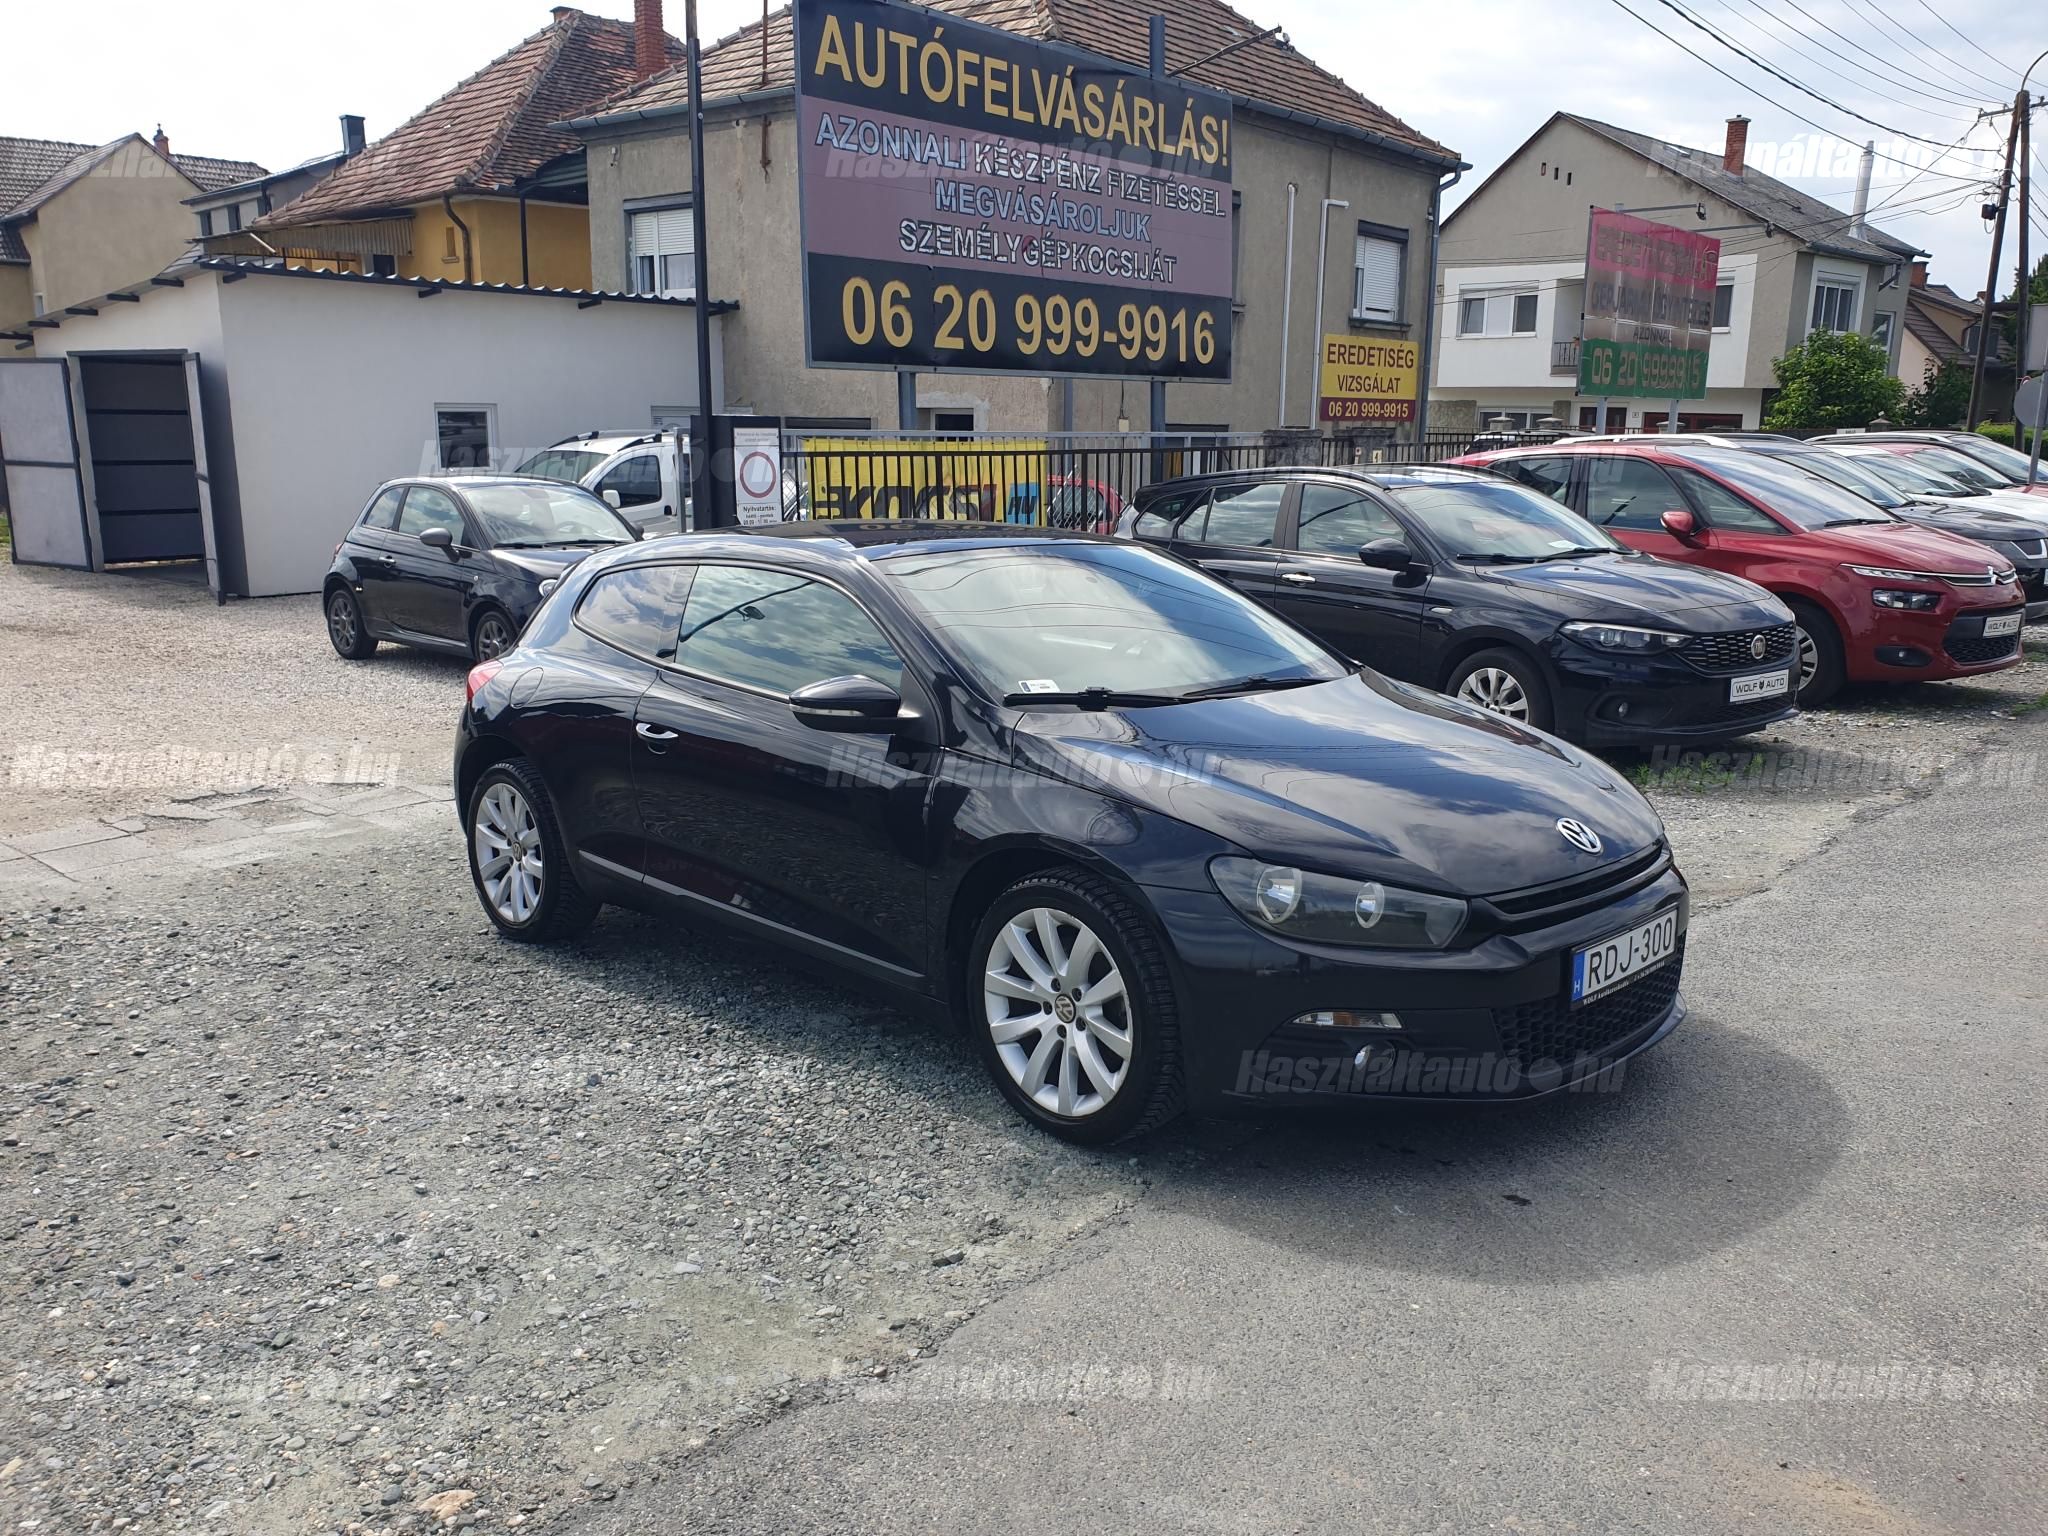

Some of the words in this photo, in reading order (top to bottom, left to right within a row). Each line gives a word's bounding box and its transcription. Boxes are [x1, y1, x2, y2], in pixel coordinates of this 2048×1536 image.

[814, 14, 1228, 166] AUTÓFELVÁSÁRLÁS!
[815, 113, 966, 170] AZONNALI
[974, 141, 1102, 195] KÉSZPÉNZ
[1107, 168, 1226, 216] FIZETÉSSEL
[935, 180, 1151, 242] MEGVÁSÁROLJUK
[899, 218, 1177, 283] SZEMÉLYGÉPKOCSIJÁT
[842, 276, 913, 348] 06
[934, 284, 996, 352] 20
[1015, 293, 1215, 364] 999-9916
[1327, 343, 1414, 368] EREDETISÉG
[1591, 347, 1612, 385] 06
[1617, 351, 1637, 387] 20
[1337, 373, 1401, 393] VIZSGÁLAT
[1328, 401, 1342, 417] 06
[1345, 401, 1358, 417] 20
[1361, 402, 1409, 417] 999-9915
[1736, 683, 1757, 694] WOLF
[1766, 677, 1784, 688] AUTO
[1588, 917, 1673, 989] RDJ-300
[1574, 979, 1581, 993] H
